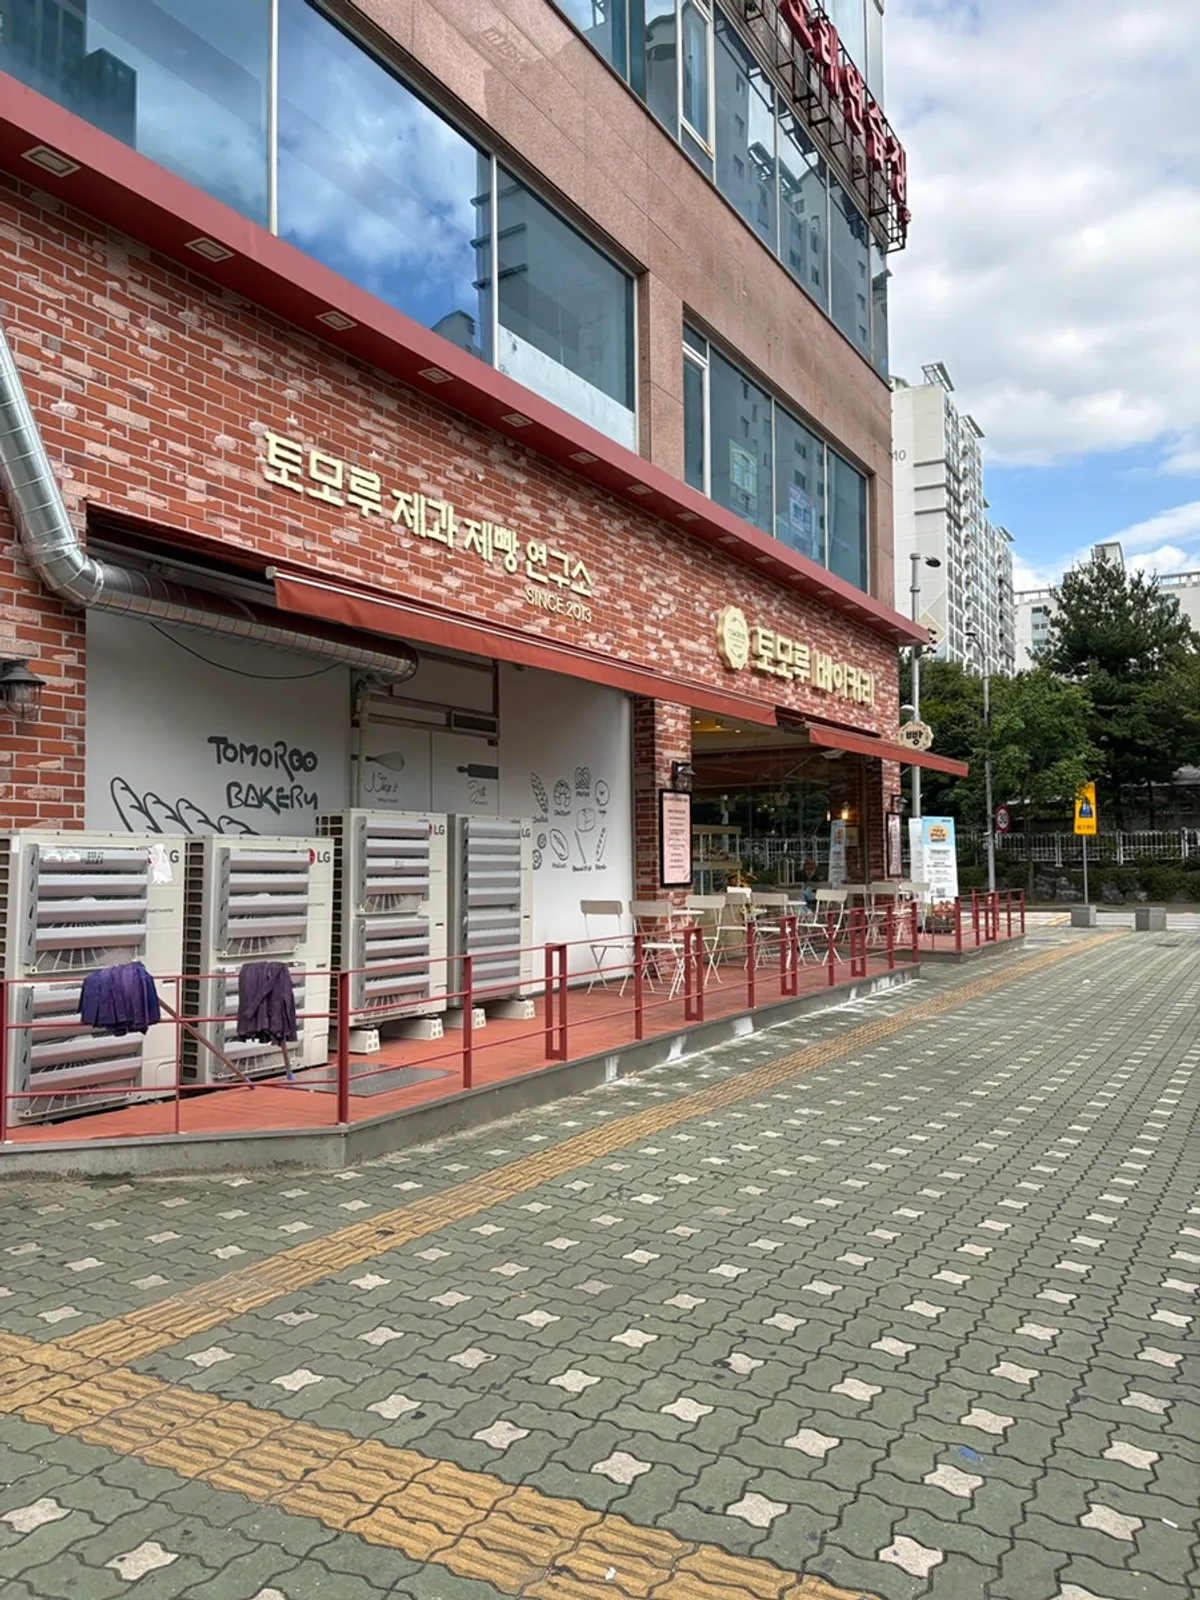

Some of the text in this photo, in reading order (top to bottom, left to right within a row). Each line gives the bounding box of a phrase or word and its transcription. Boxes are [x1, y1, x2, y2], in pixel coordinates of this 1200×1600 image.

[264, 430, 593, 598] 토모루 제과 제빵 연구소
[525, 587, 592, 623] SINCE 2013
[750, 626, 876, 707] 토모루 베이커리
[906, 730, 923, 746] 빵
[207, 736, 318, 783] TOMOROO
[433, 824, 445, 836] LG
[521, 827, 531, 838] LG
[317, 851, 331, 864] LG
